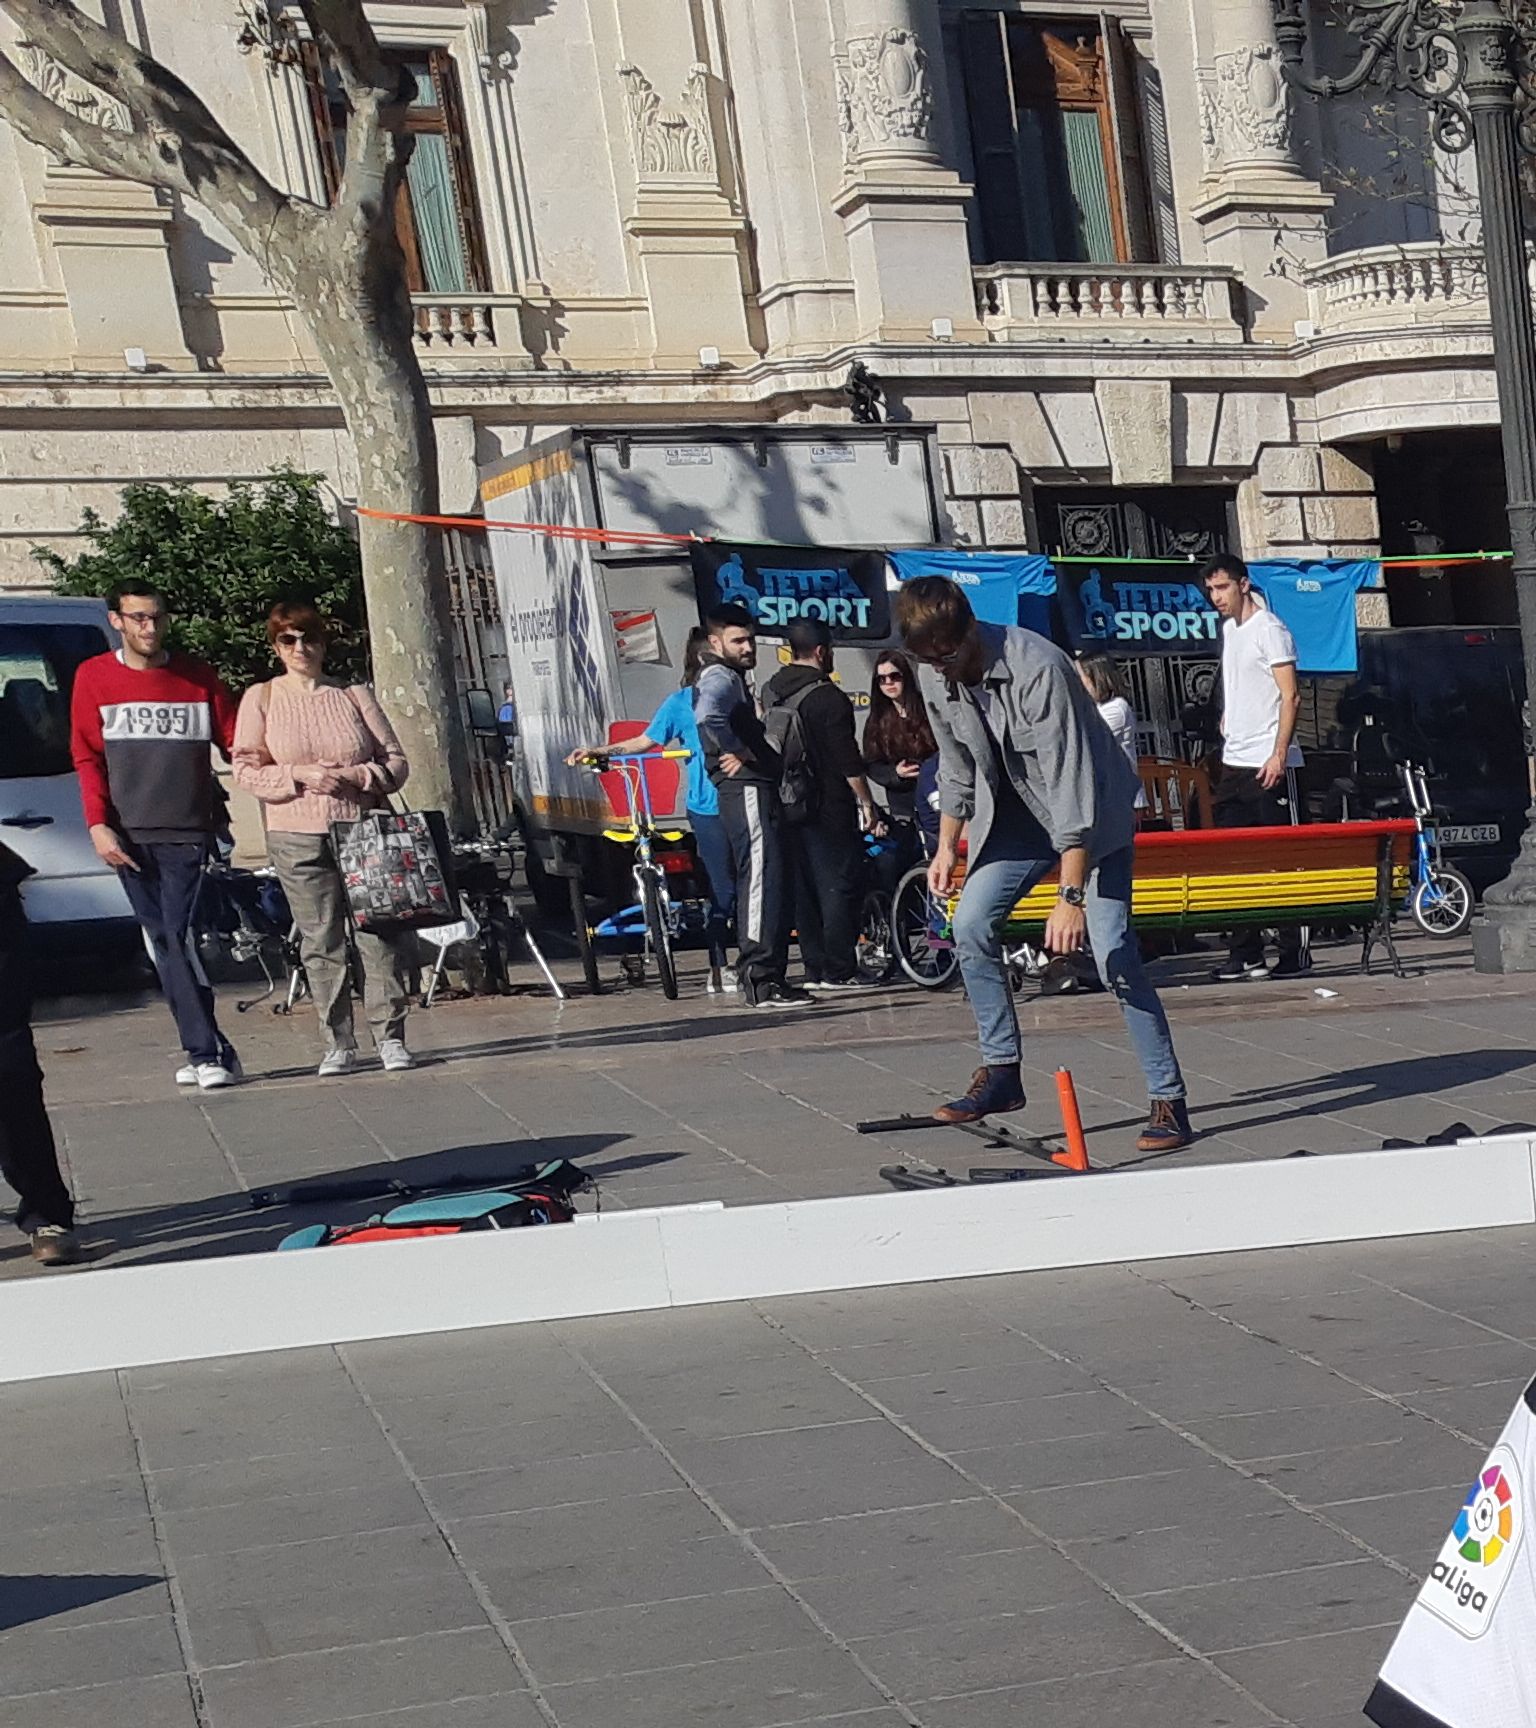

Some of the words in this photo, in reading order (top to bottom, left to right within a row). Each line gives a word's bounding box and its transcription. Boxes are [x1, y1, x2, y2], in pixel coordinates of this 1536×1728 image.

[757, 567, 864, 598] TETRA
[1112, 582, 1211, 612] TETRA
[758, 596, 871, 629] SPORT
[1114, 611, 1220, 641] SPORT
[122, 705, 189, 735] 1985
[1439, 827, 1469, 842] 974
[1430, 1561, 1488, 1613] aLiga
